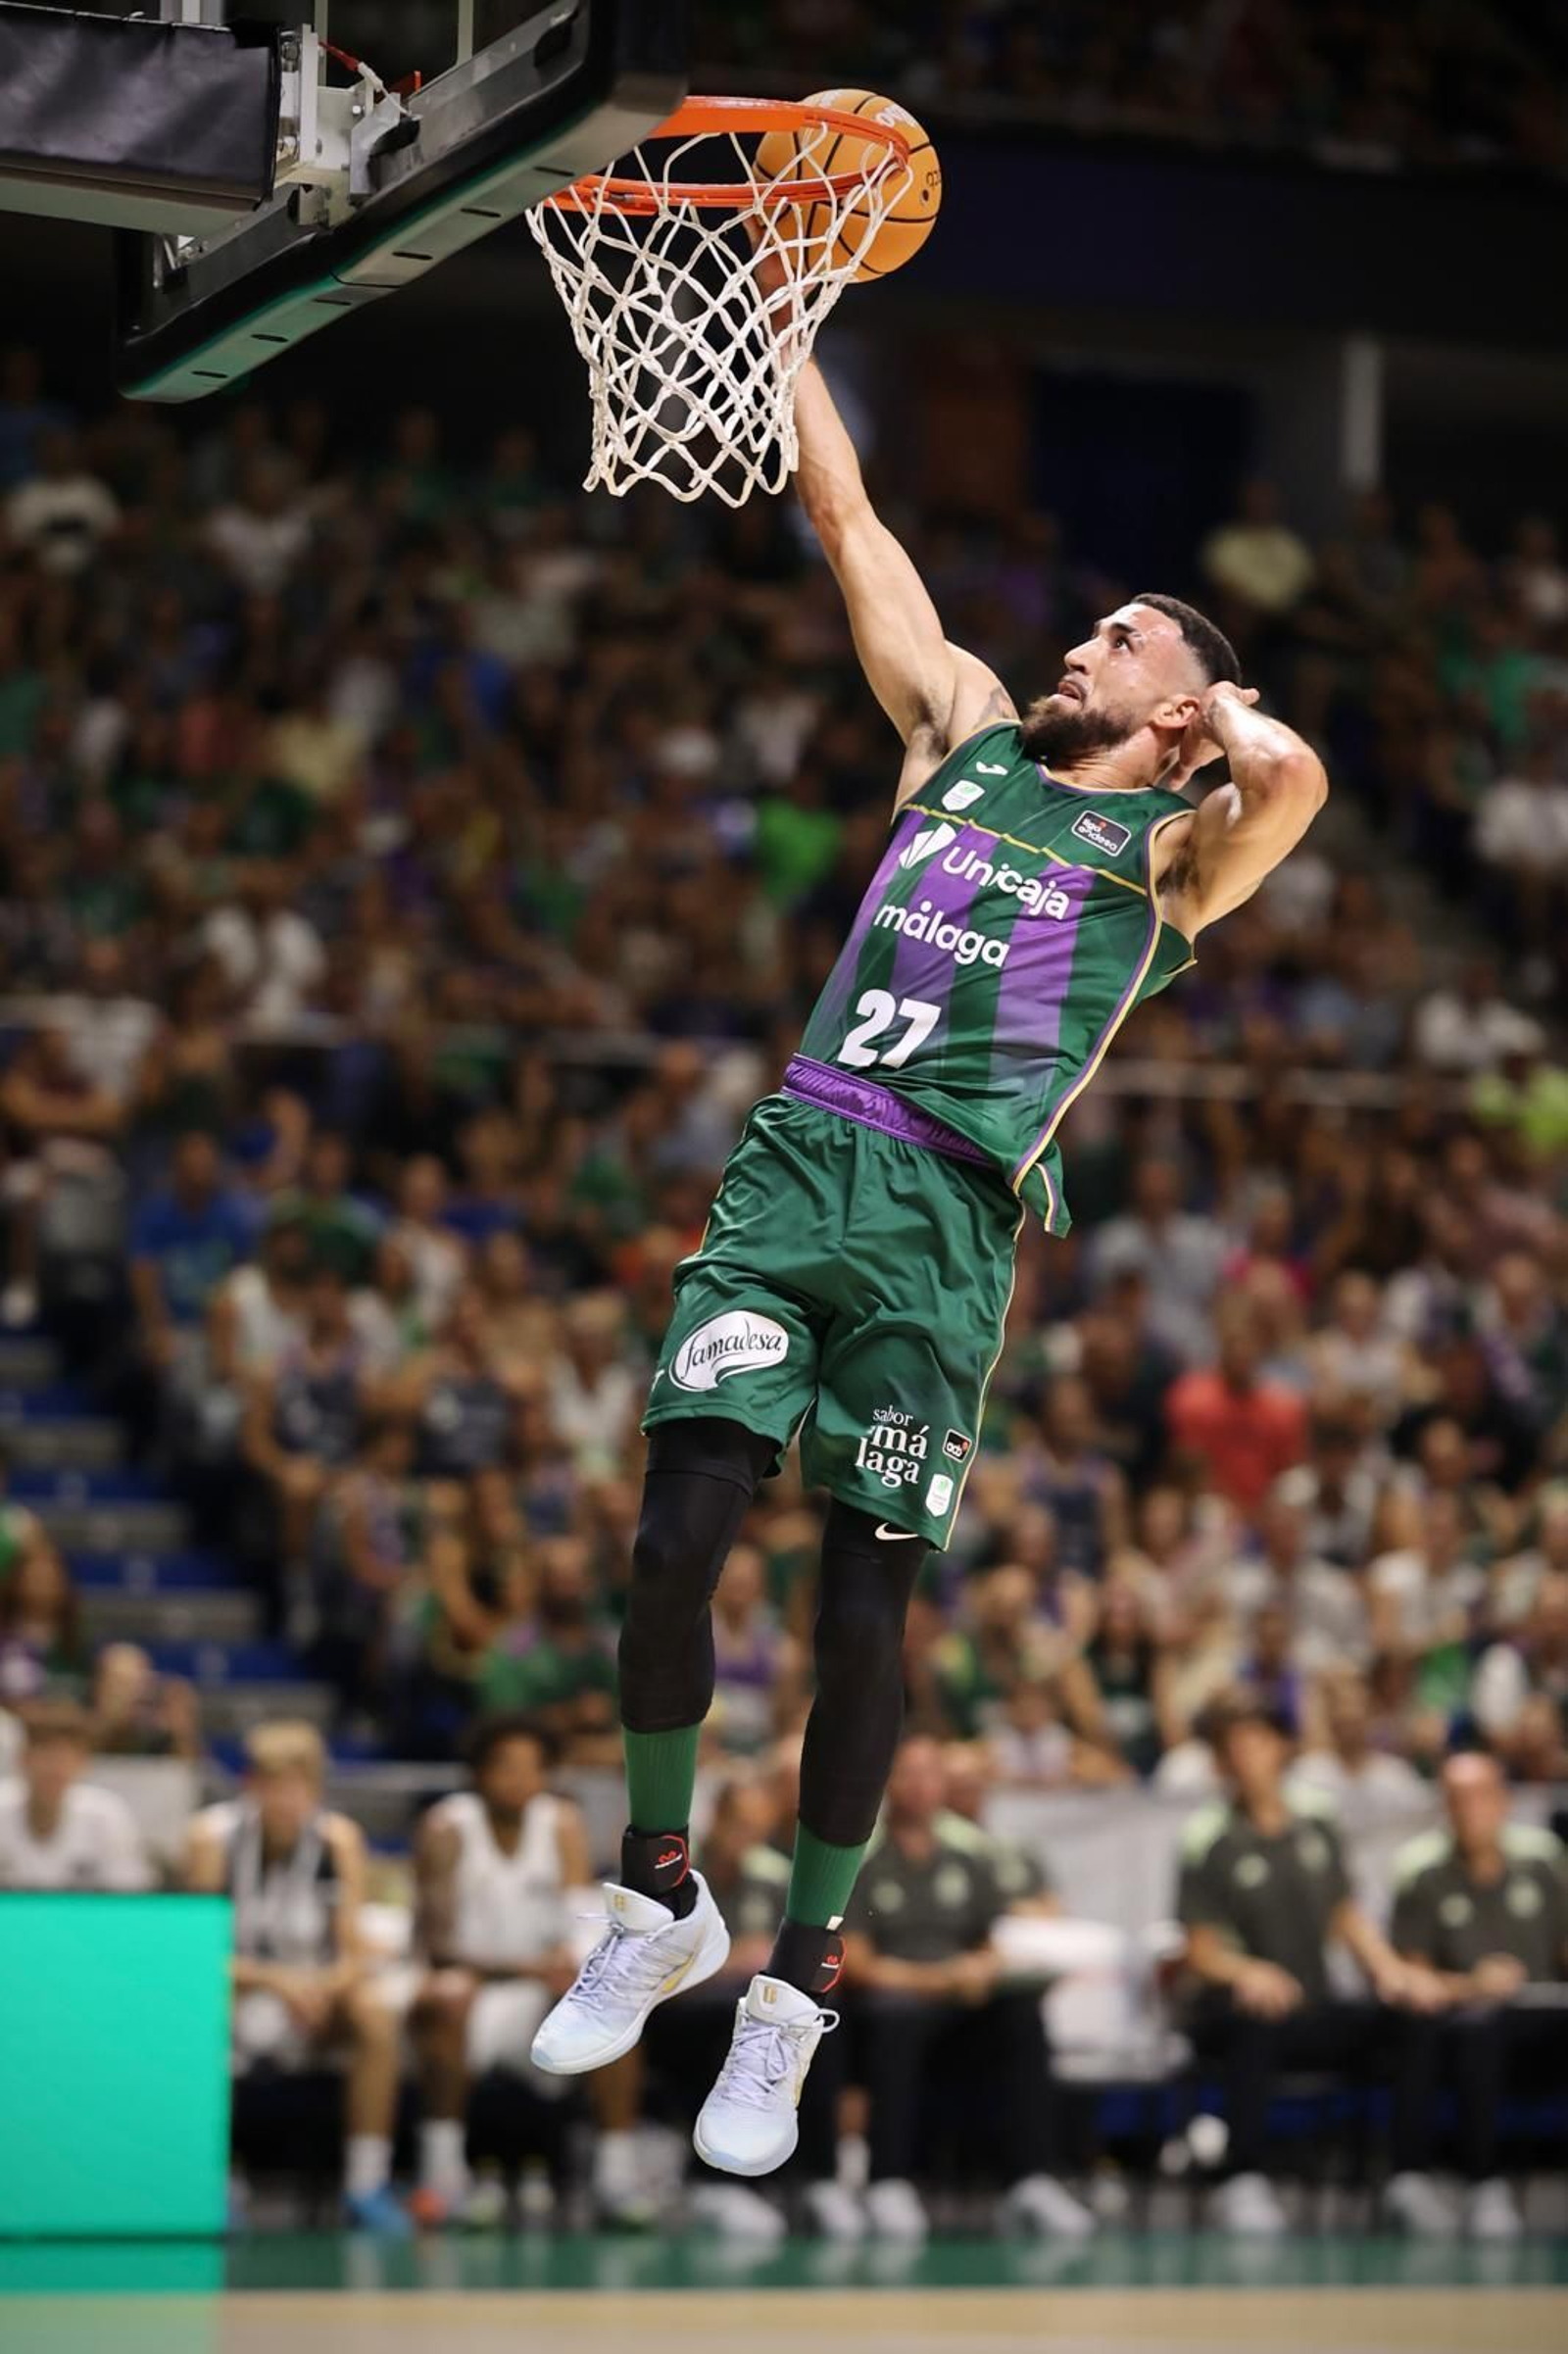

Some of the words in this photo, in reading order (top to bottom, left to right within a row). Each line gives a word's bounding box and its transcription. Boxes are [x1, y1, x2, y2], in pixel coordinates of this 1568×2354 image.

[943, 846, 1070, 920] Unicaja
[873, 900, 1010, 967] málaga
[837, 989, 941, 1069] 27
[680, 1318, 782, 1380] famadesa
[867, 1424, 930, 1460] má
[873, 1404, 913, 1426] sabor
[855, 1436, 920, 1488] laga
